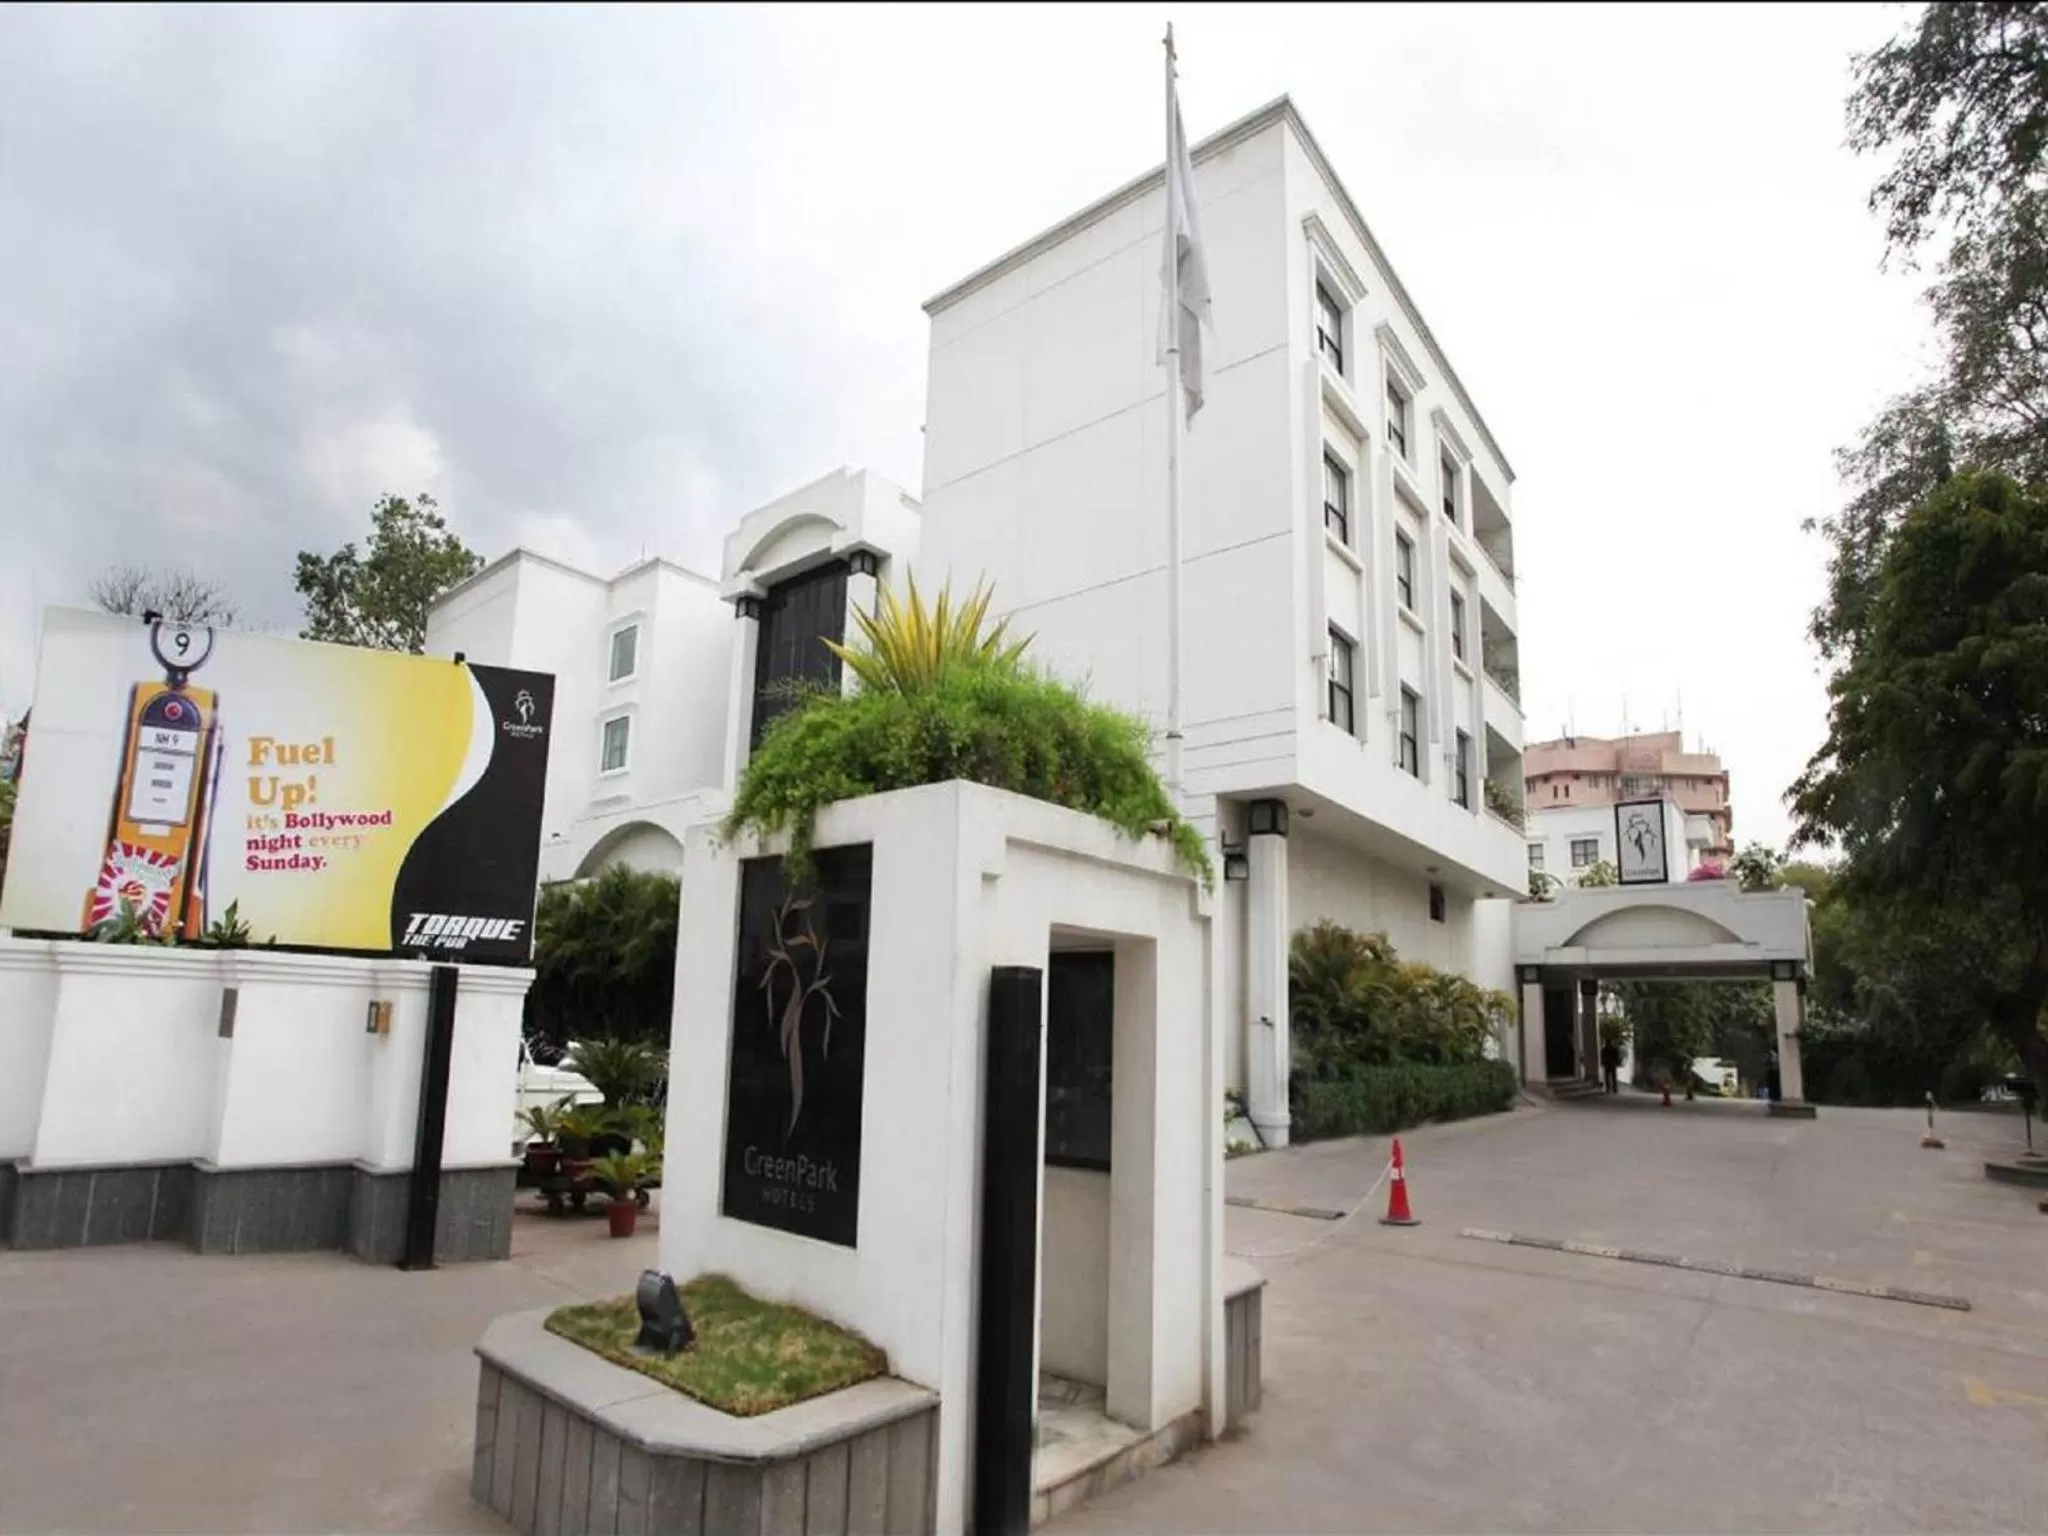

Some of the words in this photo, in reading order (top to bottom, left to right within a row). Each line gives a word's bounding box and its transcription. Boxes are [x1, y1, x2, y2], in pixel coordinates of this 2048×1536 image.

[175, 632, 190, 656] 9
[247, 736, 335, 766] Fuel
[247, 775, 317, 810] Up!
[284, 810, 393, 830] Bollywood
[246, 834, 303, 853] night
[308, 834, 362, 849] every
[246, 853, 328, 871] Sunday.
[405, 913, 526, 941] TORQUE
[400, 933, 435, 946] THE
[433, 935, 469, 949] PUB
[744, 1145, 838, 1192] GreenPark
